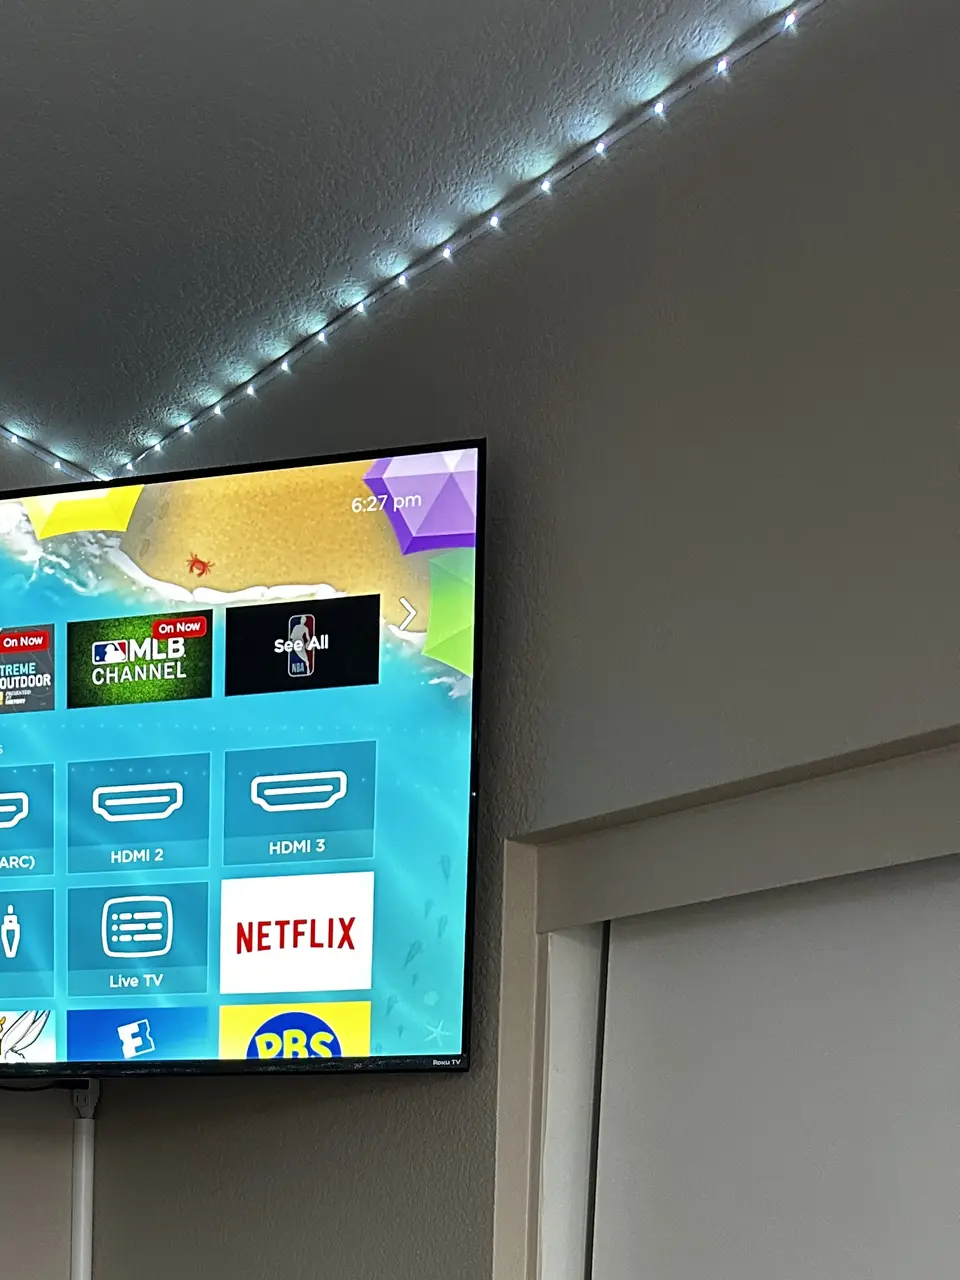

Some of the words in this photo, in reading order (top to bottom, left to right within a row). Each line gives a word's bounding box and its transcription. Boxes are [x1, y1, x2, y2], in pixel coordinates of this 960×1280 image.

[351, 495, 388, 513] 6:27
[393, 494, 422, 512] pm
[159, 623, 175, 634] On
[176, 621, 201, 633] Now
[3, 638, 18, 648] On
[20, 636, 44, 647] Now
[129, 637, 185, 662] MLB
[274, 638, 304, 653] See
[307, 633, 329, 651] All
[91, 661, 187, 685] CHANNEL
[291, 662, 305, 673] NBA
[0, 673, 52, 690] OUTDOOR
[269, 840, 311, 855] HDMI
[315, 839, 325, 853] 3
[110, 849, 150, 864] HDMI
[154, 848, 164, 862] 2
[237, 916, 356, 954] NETFLIX
[109, 974, 140, 988] Live
[142, 973, 164, 988] TV
